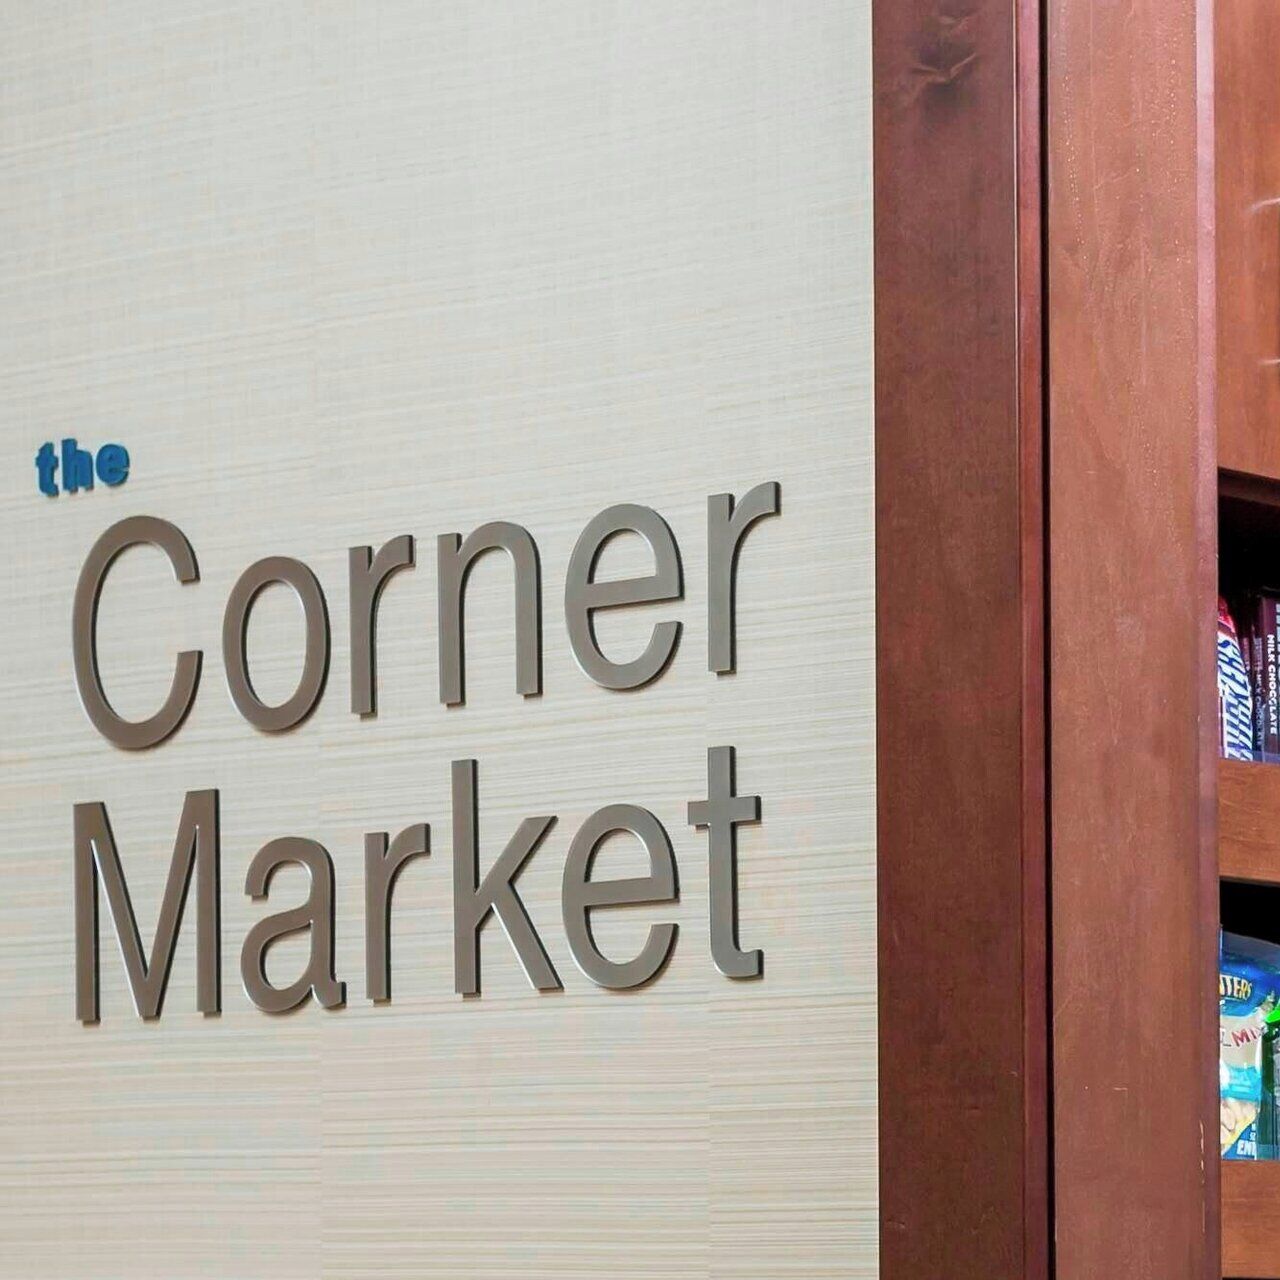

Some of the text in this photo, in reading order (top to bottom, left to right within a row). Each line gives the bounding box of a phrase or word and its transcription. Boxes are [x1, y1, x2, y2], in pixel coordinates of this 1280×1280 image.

[36, 438, 130, 496] the
[73, 481, 782, 749] Corner
[1267, 634, 1277, 735] MILK CHOCOLATE
[73, 745, 763, 1024] Market
